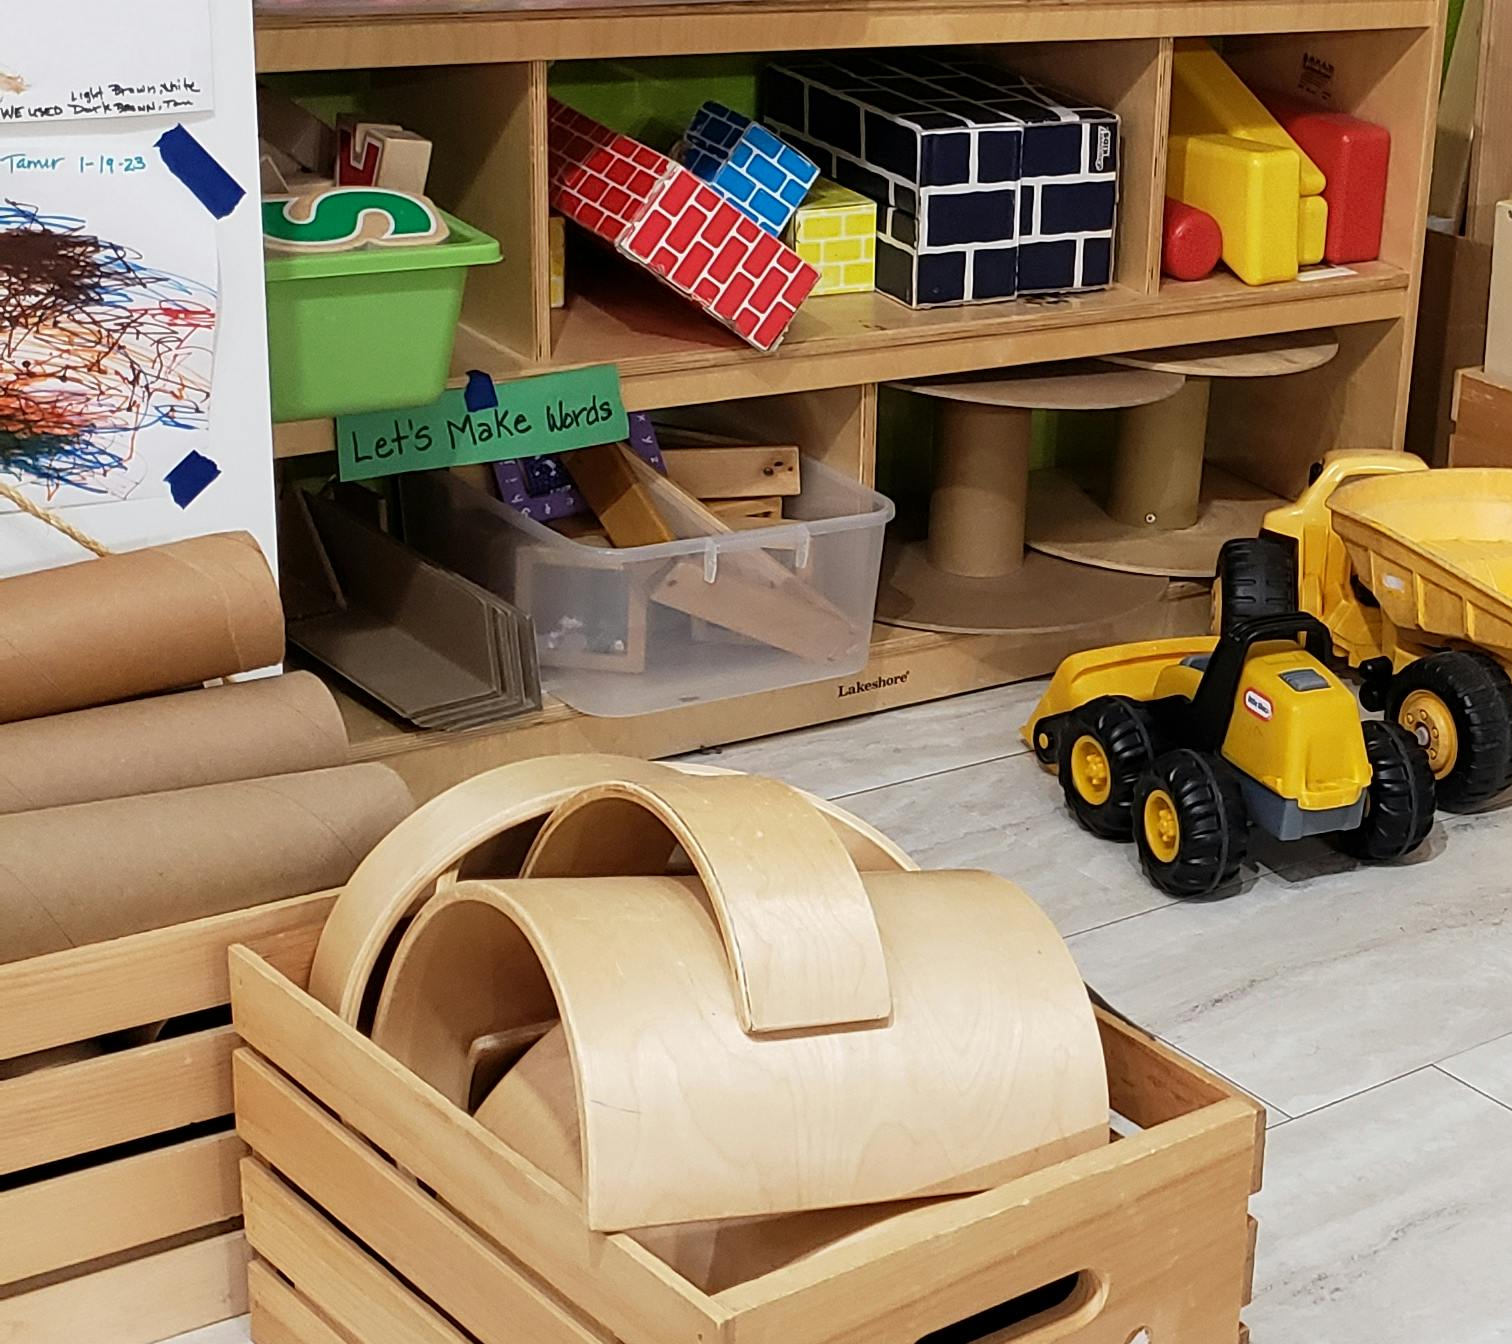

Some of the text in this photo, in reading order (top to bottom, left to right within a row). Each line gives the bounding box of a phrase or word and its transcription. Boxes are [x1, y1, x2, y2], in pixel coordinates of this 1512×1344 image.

[0, 106, 24, 119] WE
[28, 105, 63, 117] USED
[352, 395, 613, 463] Let's Make Words
